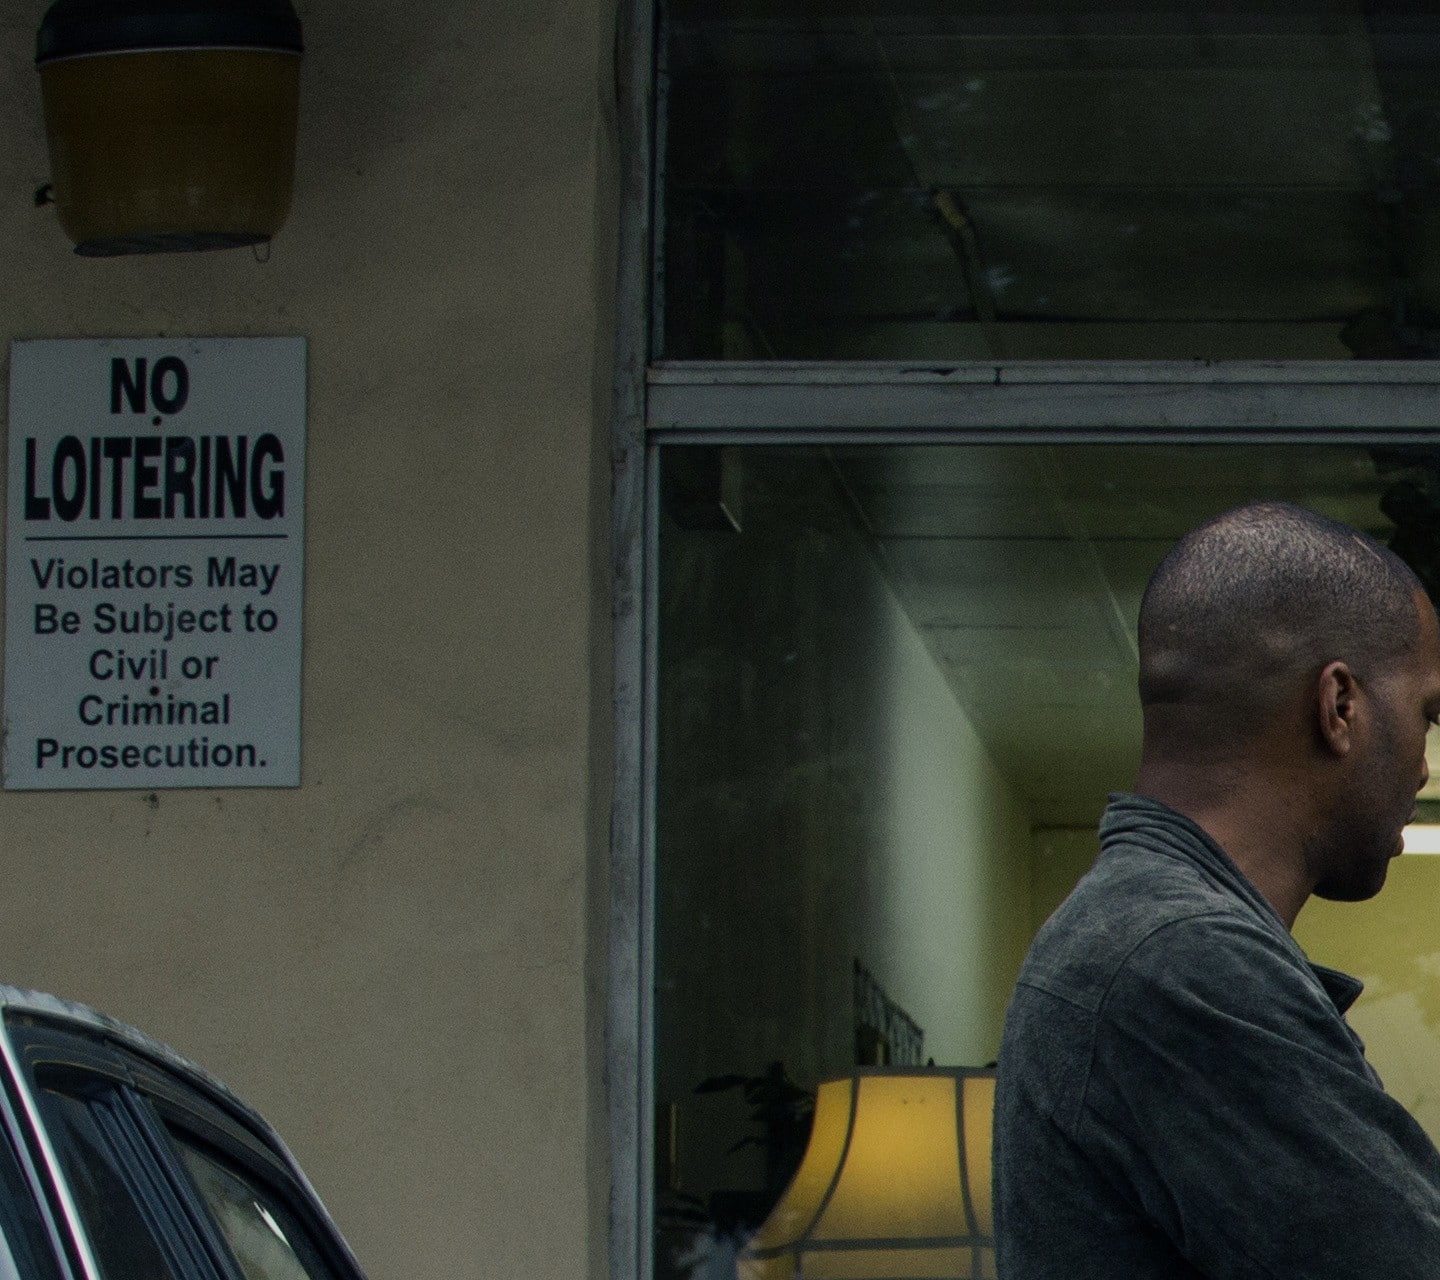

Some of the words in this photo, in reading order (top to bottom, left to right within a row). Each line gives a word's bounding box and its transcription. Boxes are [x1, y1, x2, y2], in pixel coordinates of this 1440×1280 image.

[109, 355, 190, 415] NO
[23, 433, 285, 522] LOITERING
[31, 558, 194, 590] Violators
[206, 556, 280, 595] May
[33, 603, 81, 635] Be
[93, 602, 232, 641] Subject
[243, 604, 279, 633] to
[88, 648, 168, 681] Civil
[181, 655, 219, 681] or
[78, 693, 230, 726] Criminal
[35, 737, 267, 769] Prosecution.
